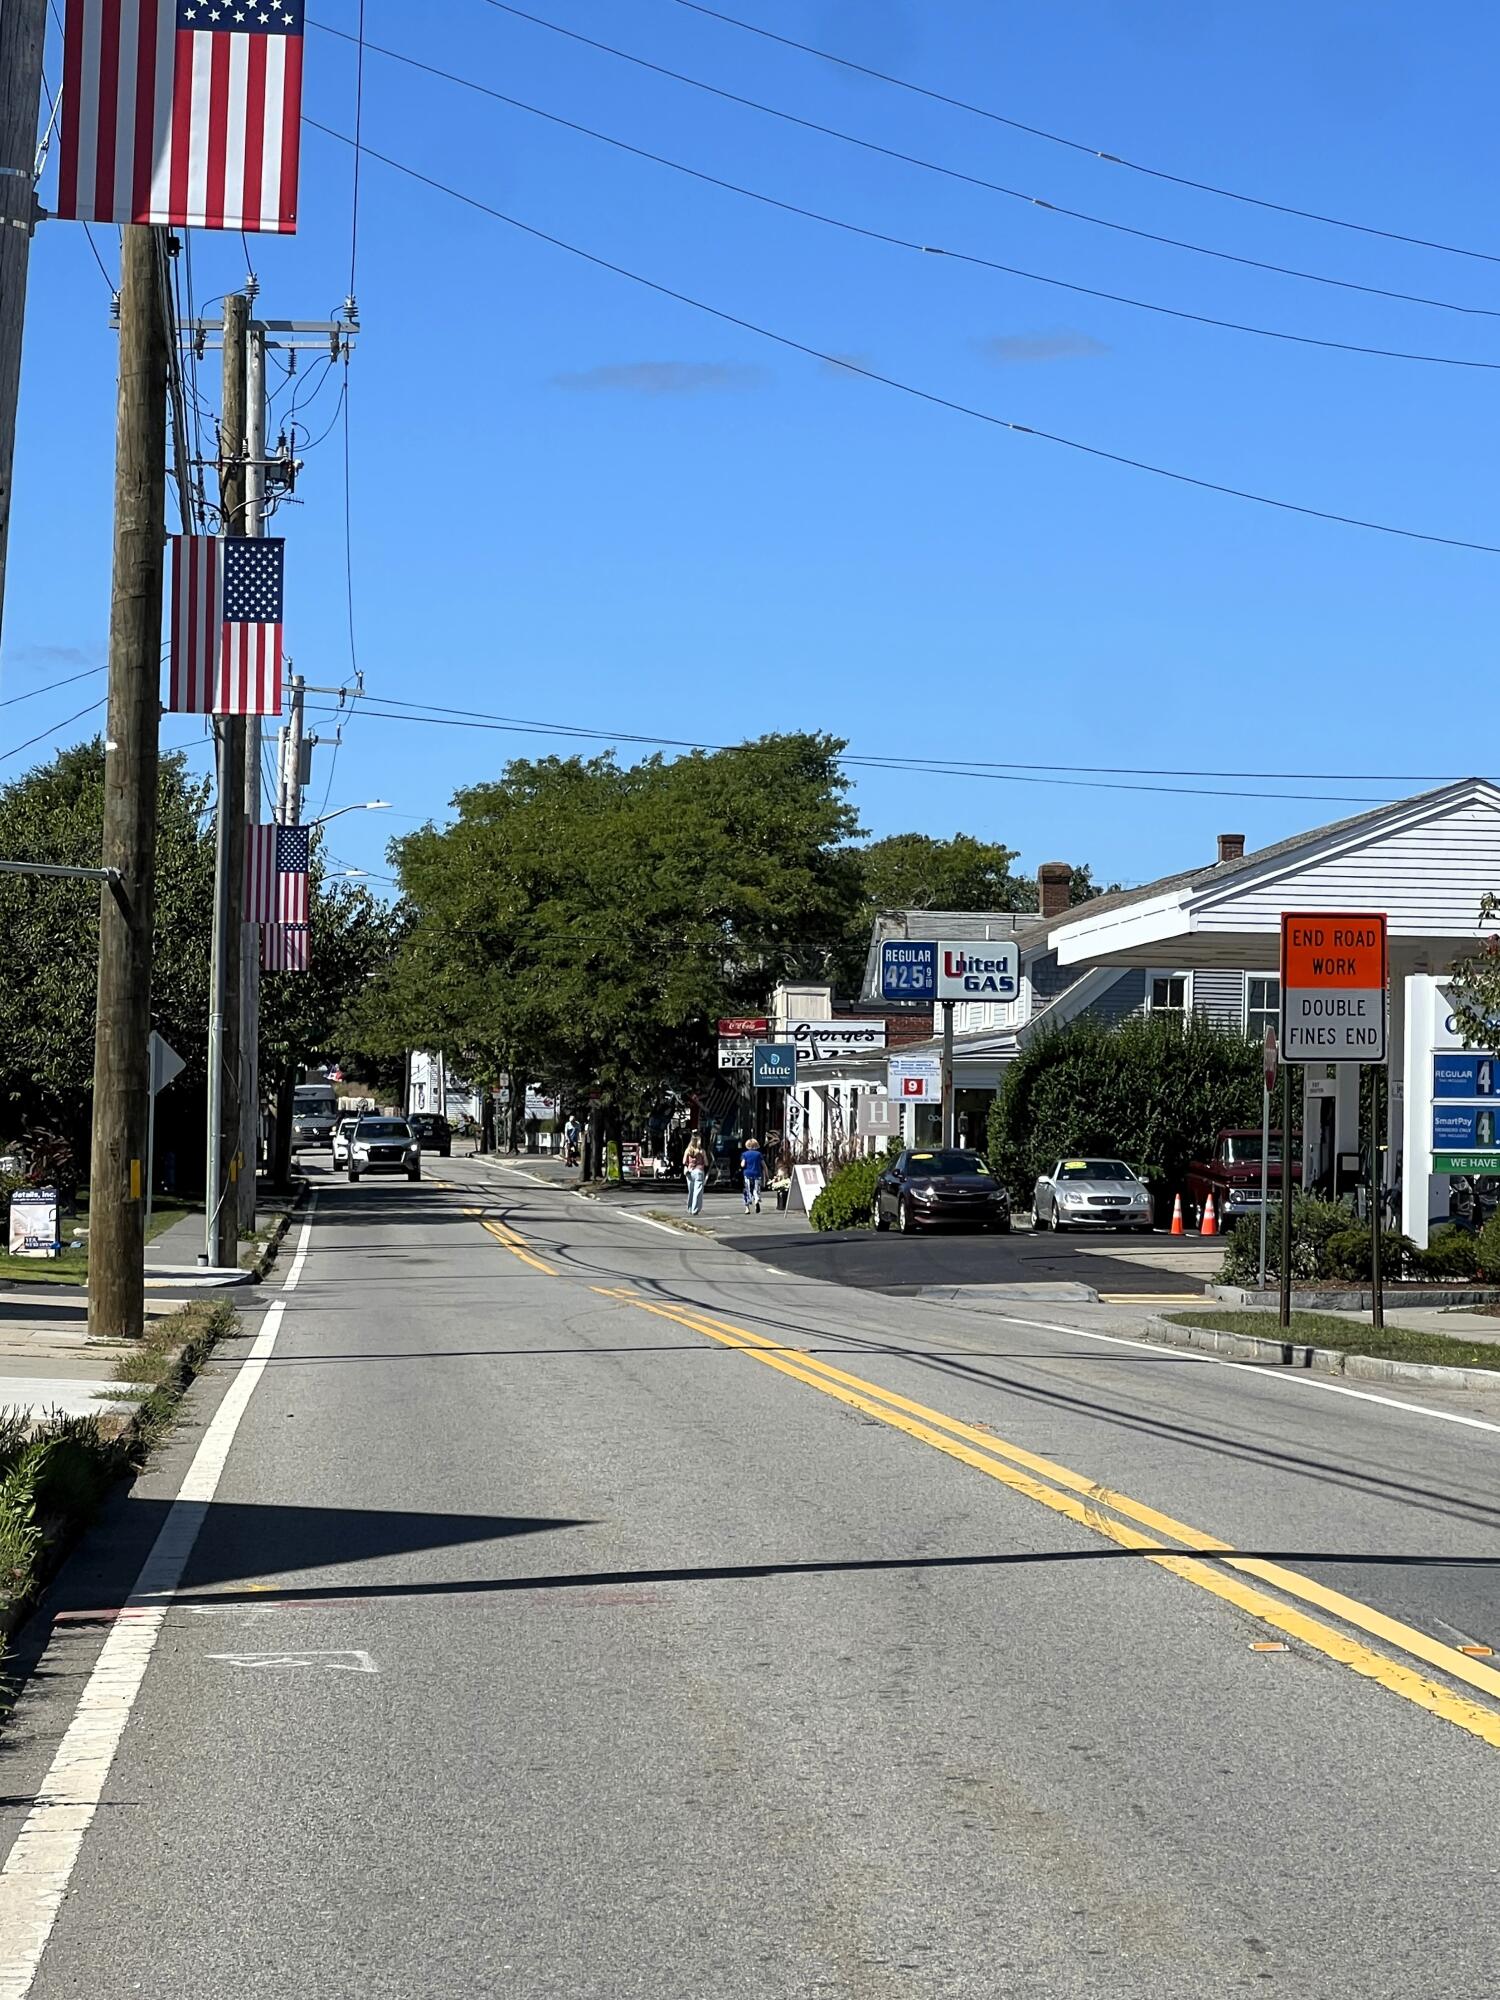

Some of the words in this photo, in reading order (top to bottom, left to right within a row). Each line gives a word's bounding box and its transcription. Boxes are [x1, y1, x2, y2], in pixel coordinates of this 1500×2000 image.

[1293, 929, 1324, 947] END
[1334, 930, 1376, 947] ROAD
[885, 949, 931, 963] REGULAR
[944, 951, 1009, 978] United
[1312, 958, 1357, 975] WORK
[964, 976, 1015, 992] GAS
[1302, 999, 1366, 1017] DOUBLE
[794, 1023, 877, 1043] George's
[1290, 1027, 1336, 1045] FINES
[1346, 1028, 1377, 1045] END
[759, 1063, 791, 1075] dune
[1435, 1070, 1473, 1078] REGULAR
[908, 1080, 918, 1092] 9
[867, 1101, 890, 1123] H
[1435, 1117, 1472, 1127] SmartPay
[1451, 1158, 1467, 1167] WE
[1470, 1158, 1498, 1168] HAVE
[12, 1191, 40, 1199] details,
